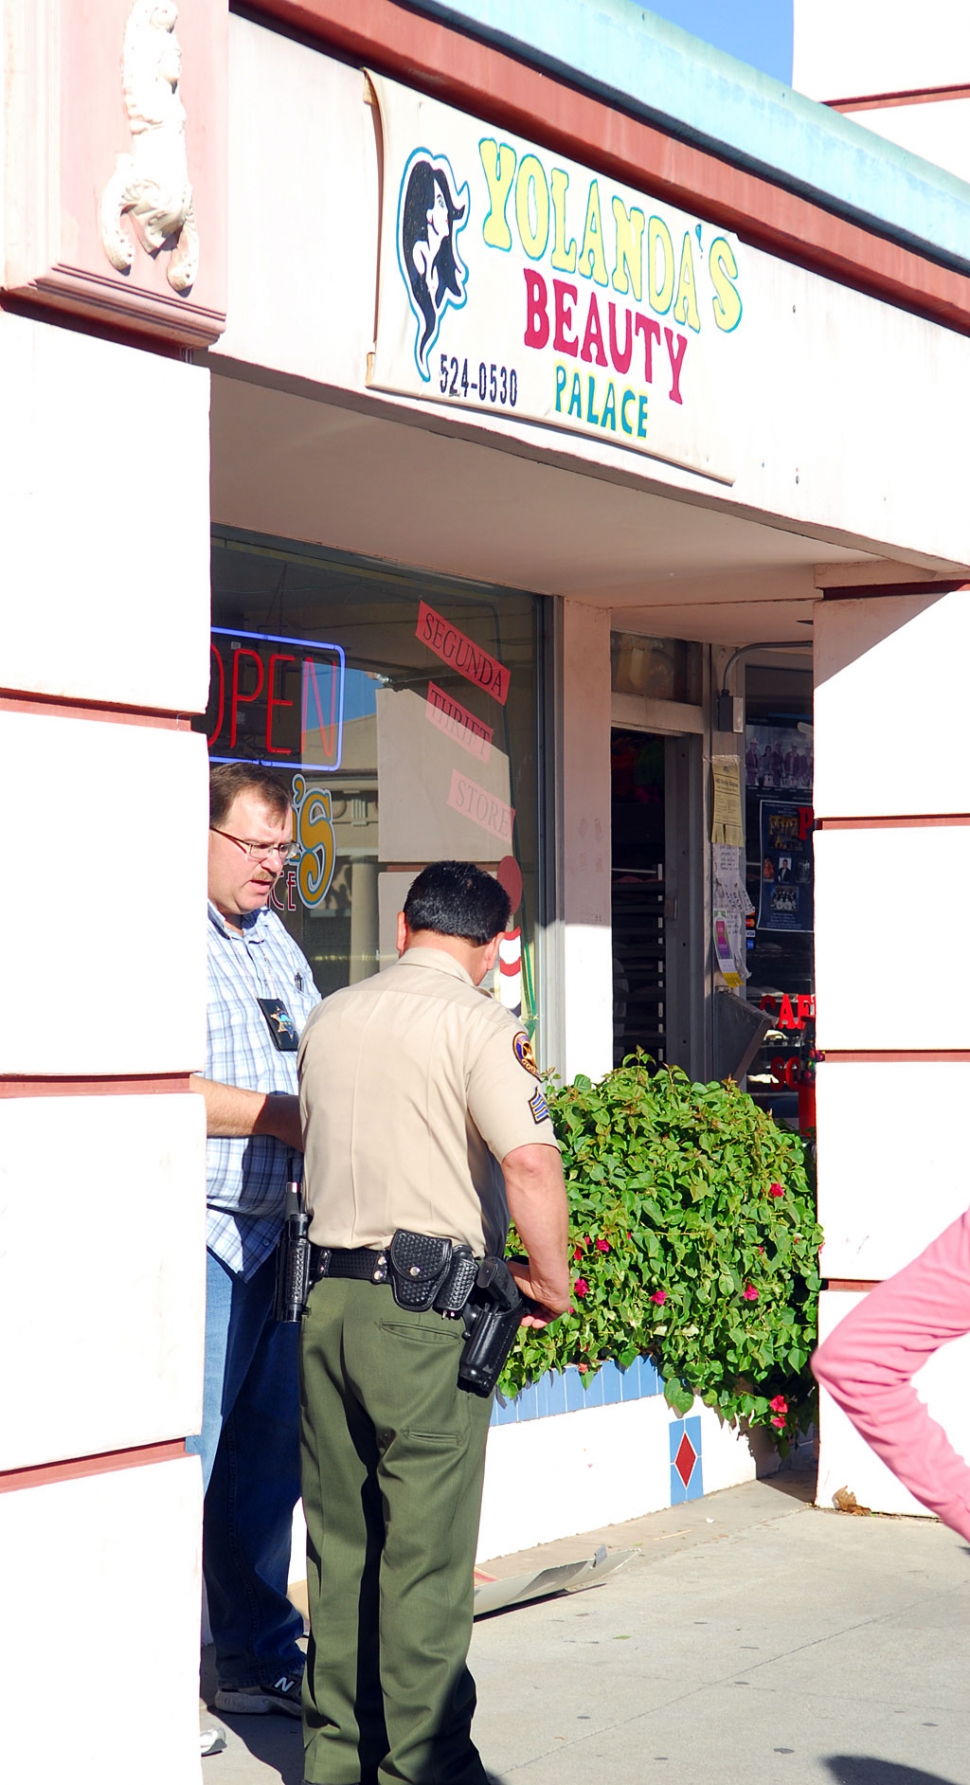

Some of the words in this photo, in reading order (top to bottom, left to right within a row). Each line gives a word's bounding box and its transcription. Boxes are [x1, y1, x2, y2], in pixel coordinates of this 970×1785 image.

[478, 138, 743, 333] YOLANDA'S
[523, 267, 688, 405] BEAUTY
[439, 354, 518, 407] 524-0530
[554, 360, 649, 439] PALACE
[422, 612, 503, 699] SEGUNDA
[430, 688, 491, 756] THRIFT
[455, 779, 510, 837] STORE
[274, 1677, 294, 1692] N
